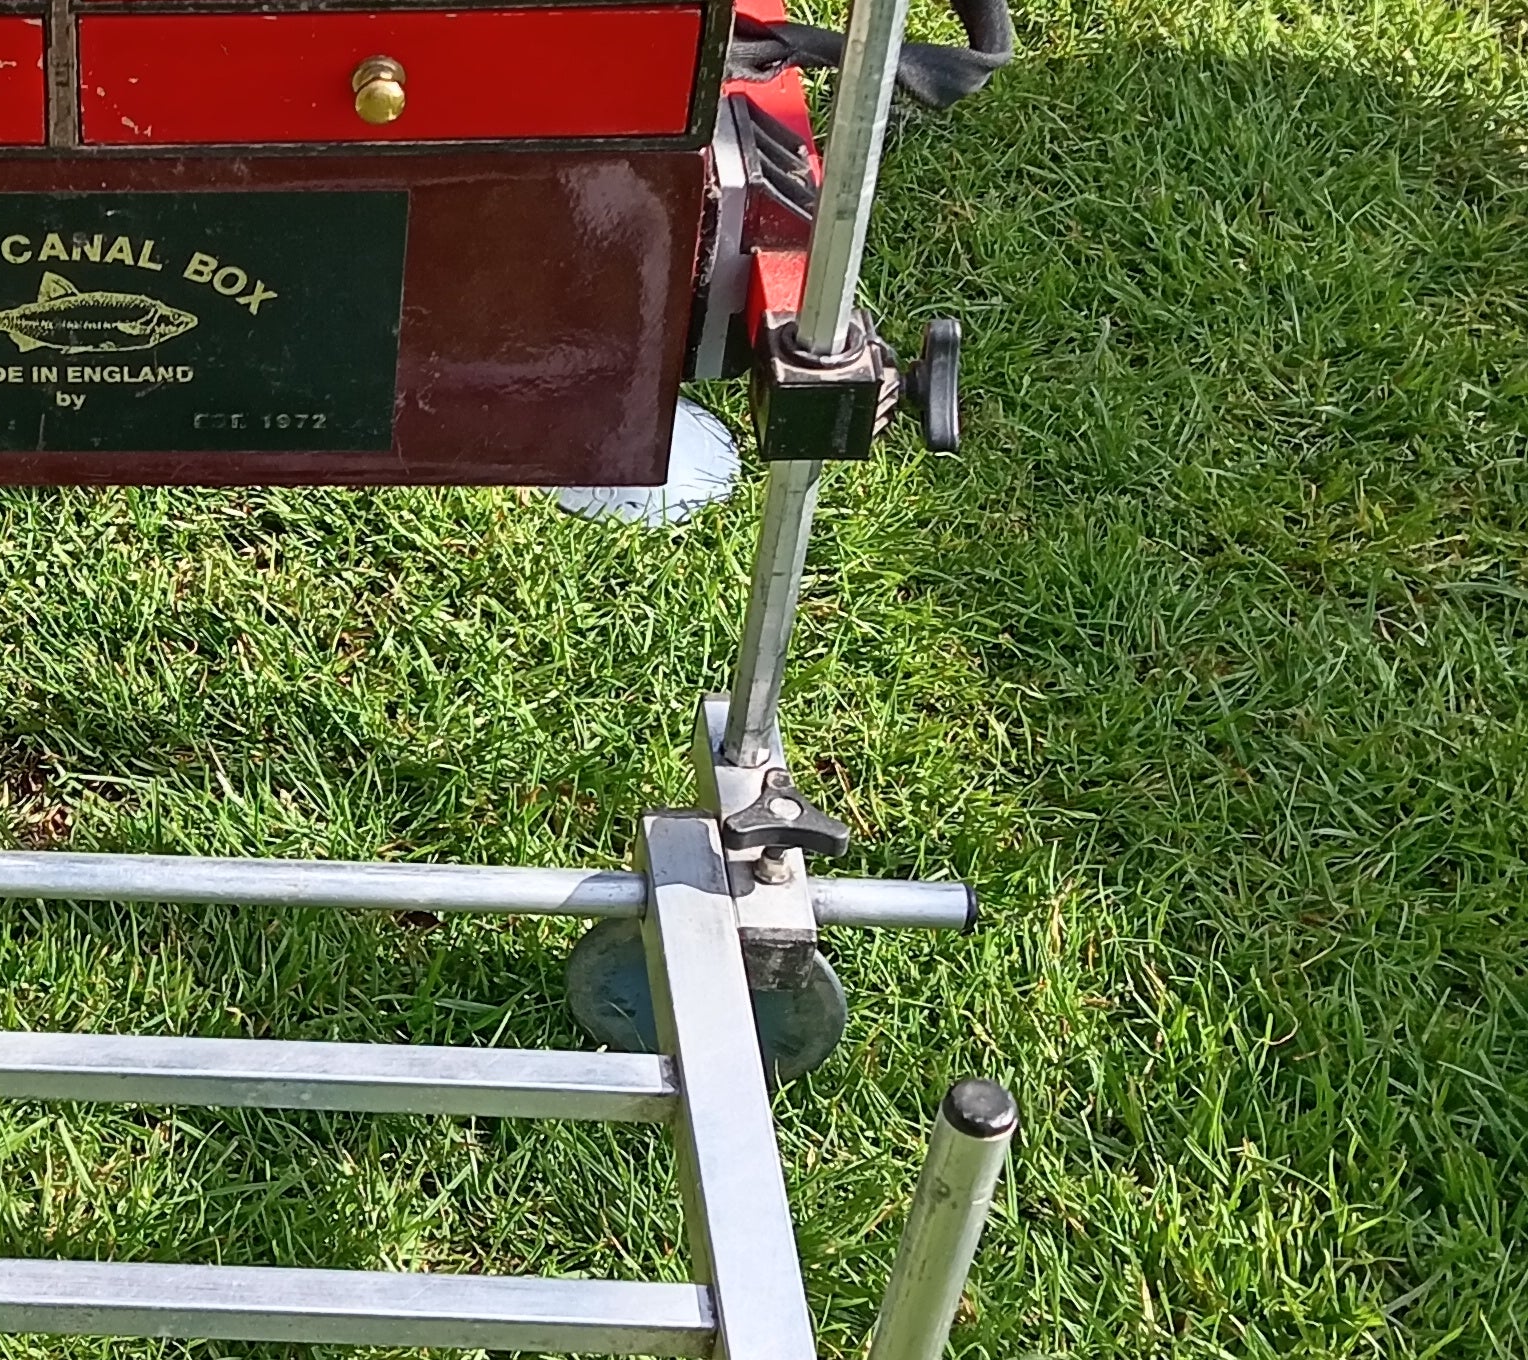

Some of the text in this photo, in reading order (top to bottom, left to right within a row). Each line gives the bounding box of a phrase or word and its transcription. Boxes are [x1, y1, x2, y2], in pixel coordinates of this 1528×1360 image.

[1, 233, 164, 272] CANAL
[183, 251, 279, 316] BOX
[32, 365, 58, 384] IN
[67, 365, 195, 384] ENGLAND
[55, 391, 86, 410] by
[261, 412, 328, 429] 1972
